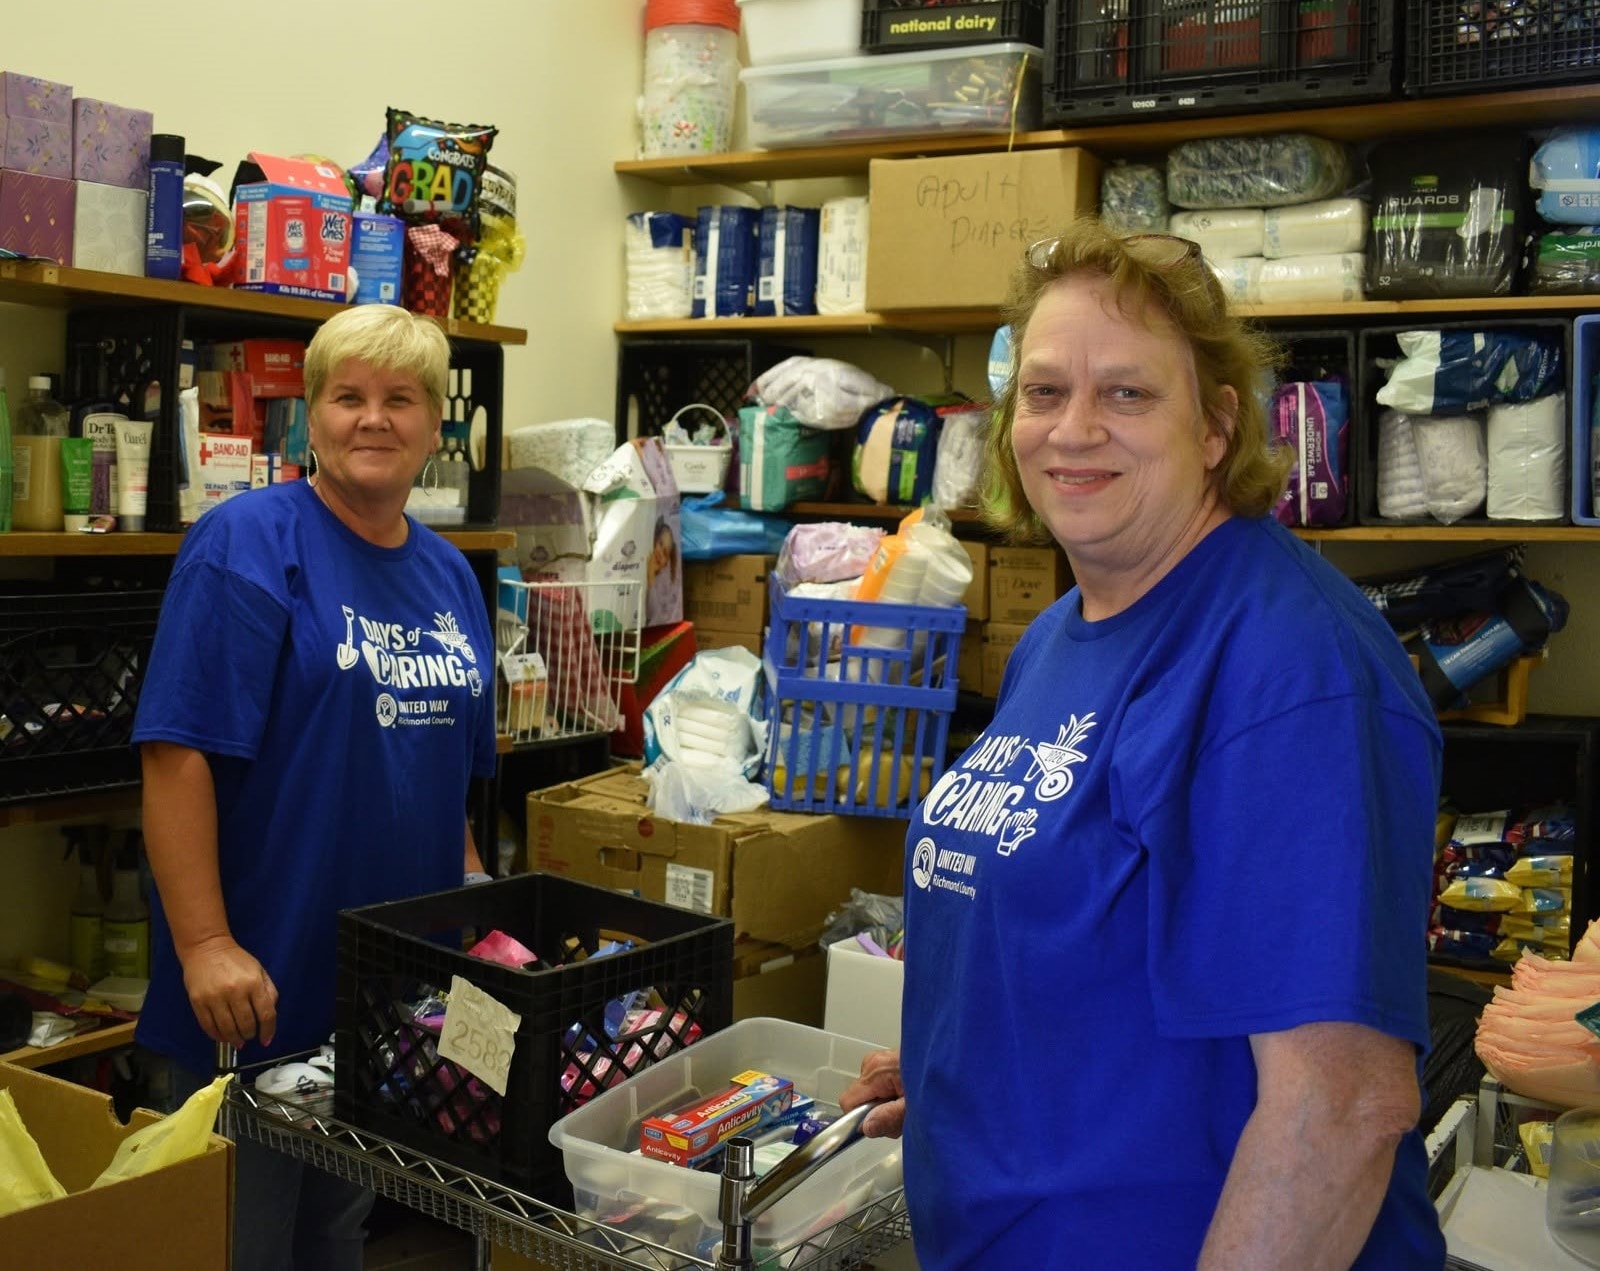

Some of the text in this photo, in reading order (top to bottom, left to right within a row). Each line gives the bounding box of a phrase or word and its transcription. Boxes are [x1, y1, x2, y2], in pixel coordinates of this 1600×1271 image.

[890, 14, 997, 34] national dairy
[427, 147, 476, 169] CONGRATS
[390, 160, 475, 213] GRAD
[1388, 194, 1460, 207] GUARDS
[323, 212, 347, 230] Wet
[321, 227, 346, 241] Ones
[1379, 276, 1391, 286] 52
[88, 423, 104, 434] Dr
[213, 442, 249, 457] BAND-AID
[1306, 417, 1316, 478] UNDERWEAR
[359, 616, 422, 651] DAYS of
[361, 640, 467, 689] CARING
[398, 700, 449, 714] UNITED WAY
[398, 715, 456, 727] Richmond County
[923, 770, 1025, 836] CARING
[937, 848, 965, 874] UNITED
[933, 874, 977, 900] Richmond County
[697, 1091, 749, 1118] Anticavity
[716, 1104, 764, 1136] Anticavity
[646, 1144, 682, 1162] Anticavity
